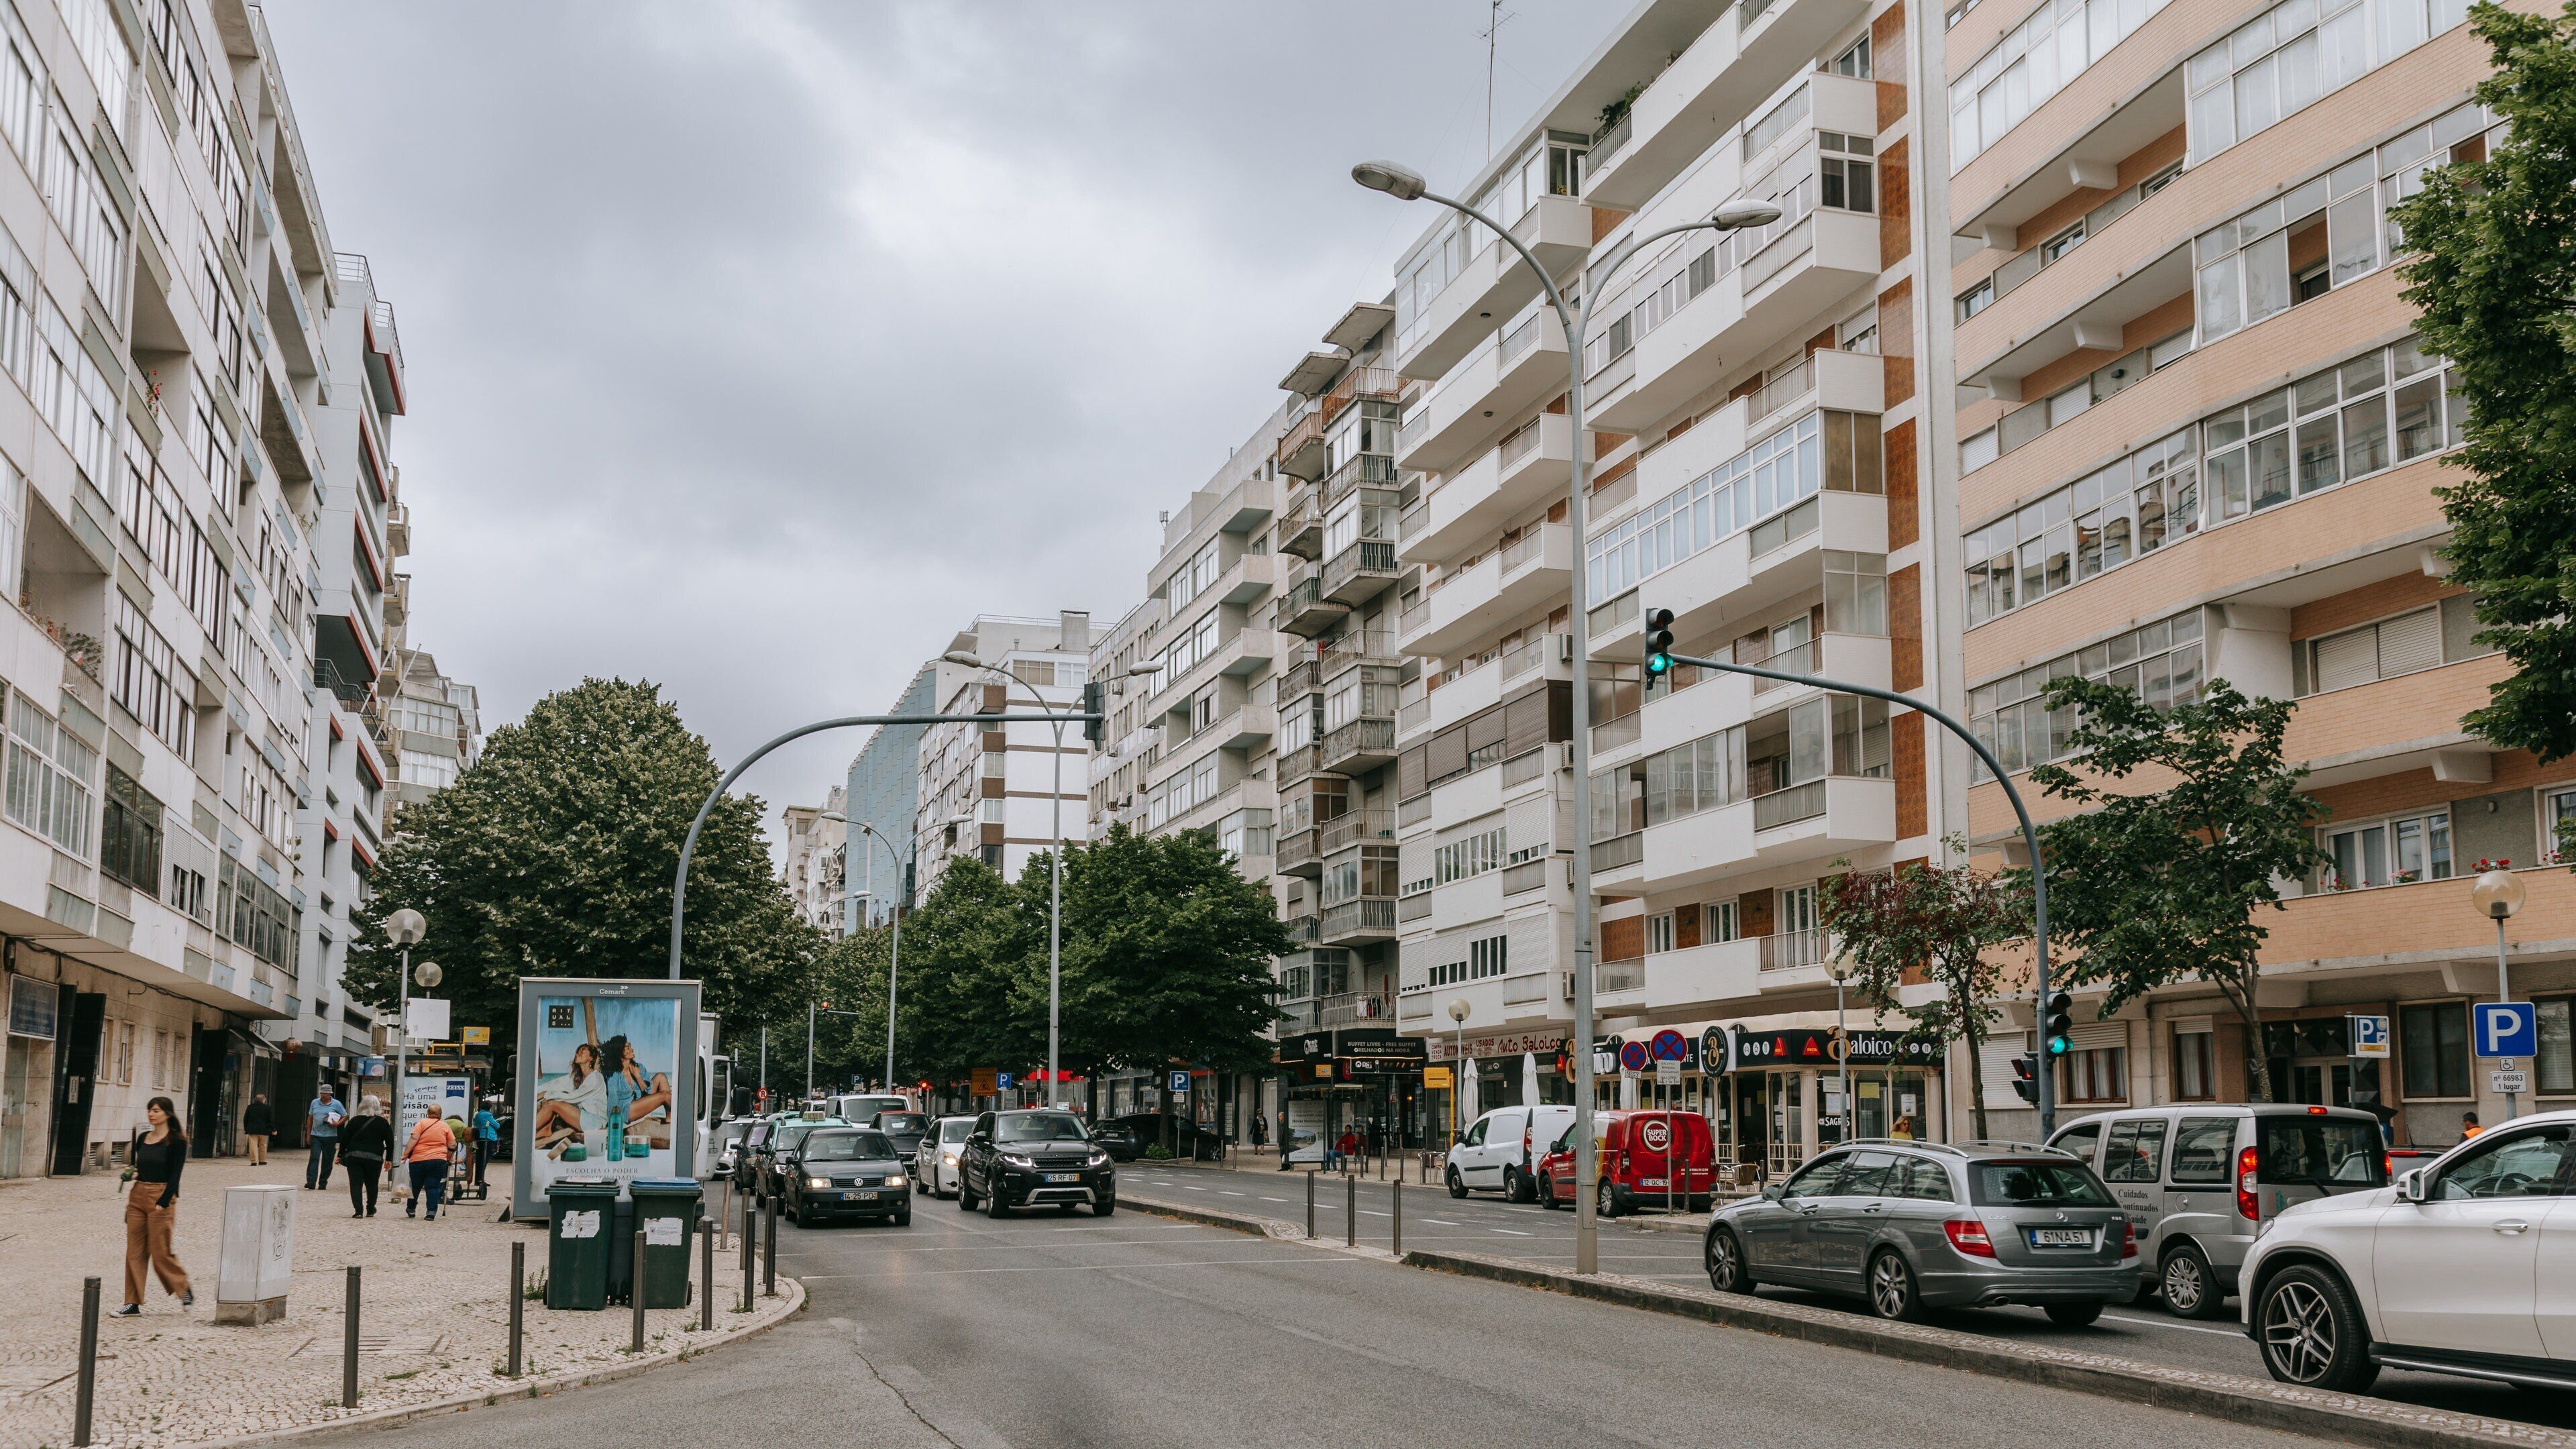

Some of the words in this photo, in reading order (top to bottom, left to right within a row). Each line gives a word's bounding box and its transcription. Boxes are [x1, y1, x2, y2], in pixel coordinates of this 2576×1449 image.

[2359, 1018, 2374, 1043] P
[2487, 1008, 2522, 1052] P
[1476, 1038, 1495, 1047] USADOS
[1497, 1038, 1518, 1053] Auto
[1000, 1074, 1008, 1085] P
[1175, 1074, 1185, 1088] P
[414, 1085, 438, 1093] sempre
[1825, 1116, 1850, 1126] SAGRS
[2118, 1189, 2148, 1199] Cuidados
[2120, 1201, 2159, 1212] ontinuados
